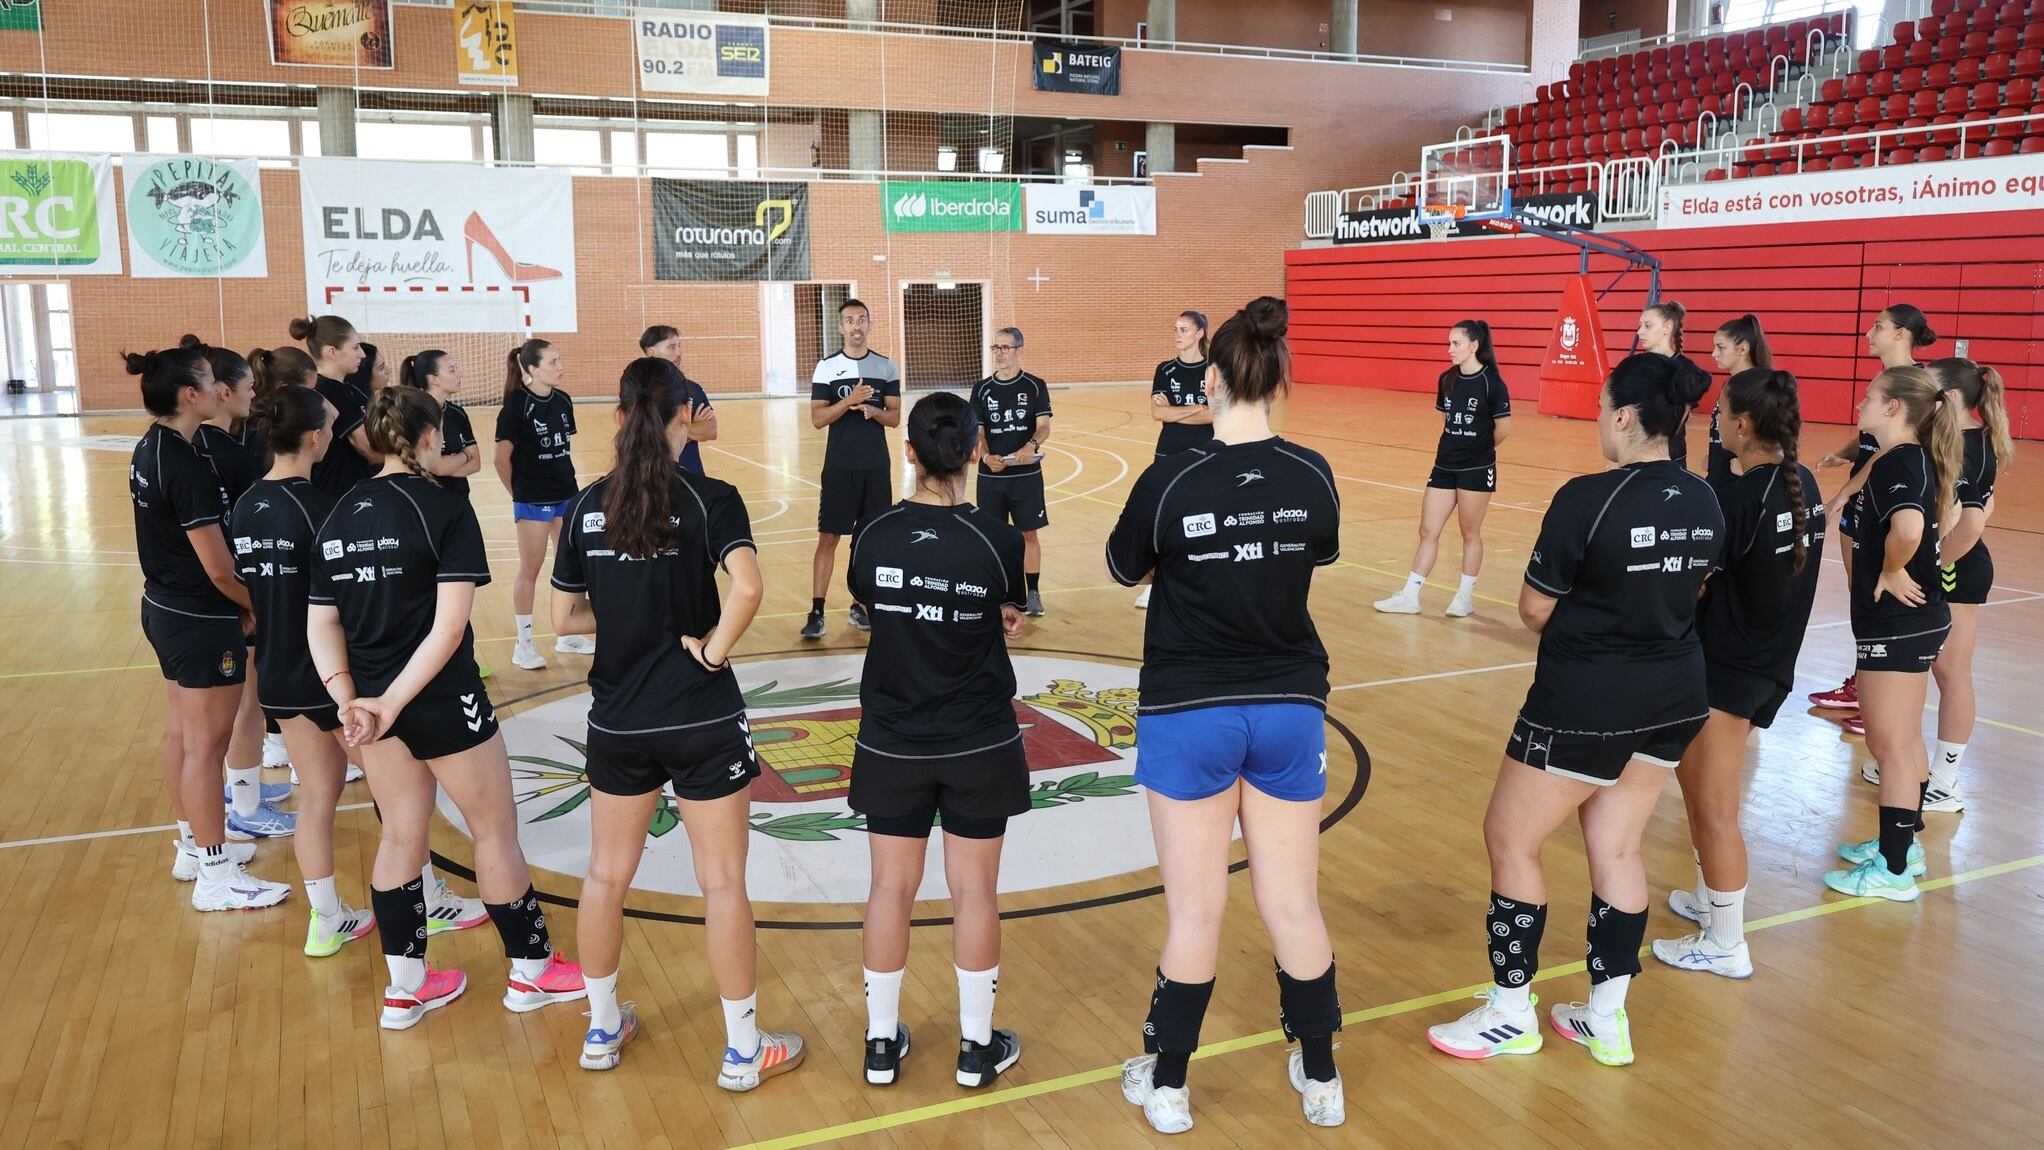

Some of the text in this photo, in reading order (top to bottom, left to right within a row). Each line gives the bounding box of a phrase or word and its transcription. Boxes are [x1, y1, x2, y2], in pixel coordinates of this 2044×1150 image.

[642, 21, 712, 40] RADIO
[643, 40, 712, 59] ELDA
[720, 46, 761, 62] SER
[643, 59, 684, 75] 90.2
[1069, 53, 1112, 68] BATEIG
[153, 160, 230, 187] PEPITA
[1682, 197, 1719, 215] Elda
[1725, 192, 1763, 212] está
[1769, 193, 1803, 209] con
[1811, 186, 1904, 206] vosotras,
[1912, 174, 1996, 199] ¡Ánimo
[930, 197, 1011, 216] Iberdrola
[322, 206, 445, 241] ELDA
[1035, 209, 1087, 224] suma
[1336, 209, 1422, 239] finetwork
[1489, 218, 1514, 230] MONDO
[675, 226, 765, 245] roturama
[23, 243, 81, 253] CENTRAL
[160, 238, 236, 263] VIAJERA
[694, 251, 709, 260] que
[710, 250, 736, 259] rótulos
[318, 249, 455, 284] Te deja huella.
[585, 518, 603, 528] CRC
[1187, 521, 1212, 532] CRC
[1634, 533, 1653, 543] CRC
[325, 545, 341, 555] CRC
[1233, 541, 1264, 562] Xti
[1662, 556, 1682, 573] Xti
[355, 566, 376, 582] Xti
[878, 573, 900, 584] CRC
[925, 580, 949, 588] TRINIDAD
[915, 603, 944, 621] Xti
[204, 858, 229, 867] adidas
